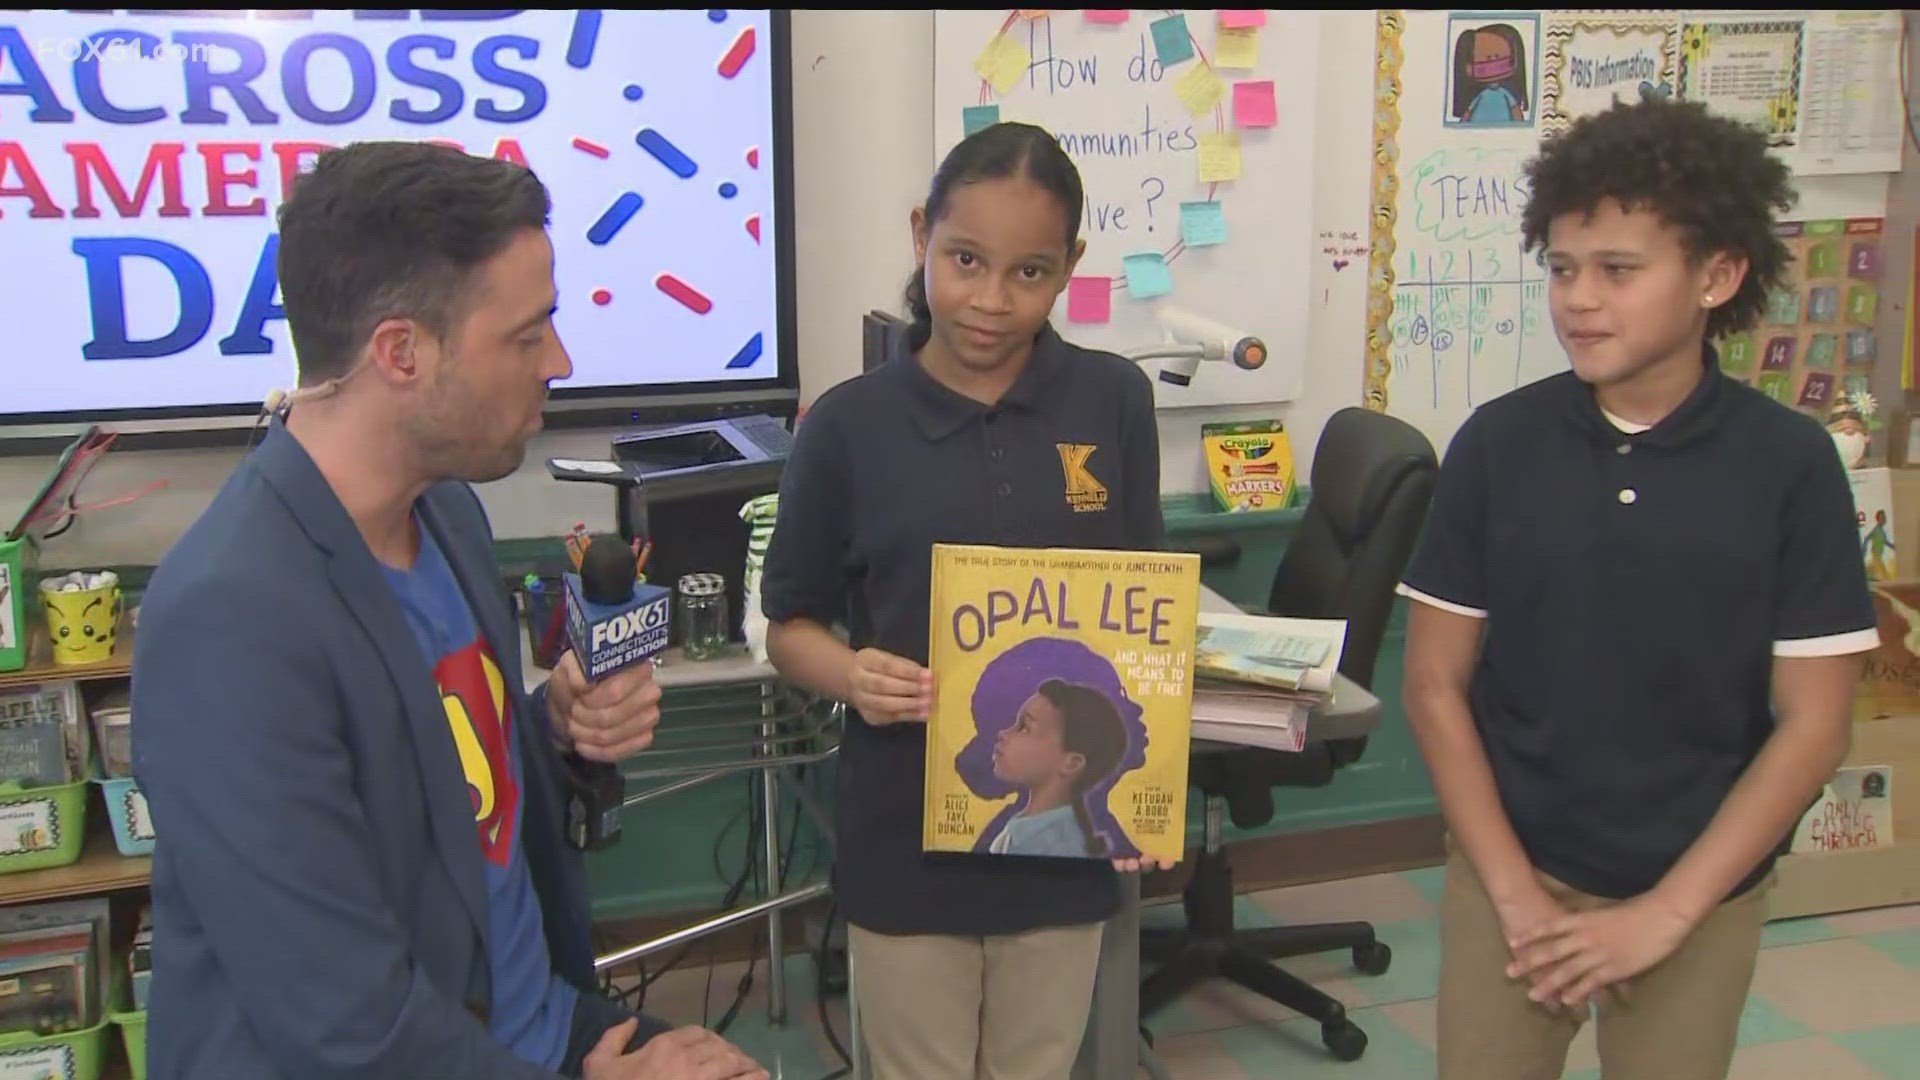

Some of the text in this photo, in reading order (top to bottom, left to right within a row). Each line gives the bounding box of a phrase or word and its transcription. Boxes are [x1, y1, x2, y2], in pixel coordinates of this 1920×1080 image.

[0, 24, 548, 126] ACROSS
[1027, 15, 1165, 95] How do
[1569, 55, 1593, 89] PBIS
[1594, 48, 1656, 88] Information
[1055, 103, 1198, 159] mmunities
[0, 137, 530, 219] AMER
[1085, 193, 1129, 232] lve
[71, 232, 289, 361] DA
[1224, 436, 1271, 452] Crayola
[1056, 443, 1107, 493] K
[1226, 479, 1285, 499] MARKERS
[1126, 561, 1183, 574] JUNETEENTH
[952, 577, 1175, 652] OPAL LEE
[592, 626, 668, 664] CONNECTICUT'S
[592, 636, 668, 677] NEWS STATION
[1114, 649, 1187, 667] AND WHAT IT
[1126, 664, 1185, 682] MEANS TO
[1137, 681, 1185, 697] BE FREE
[937, 822, 975, 836] DUNCAN
